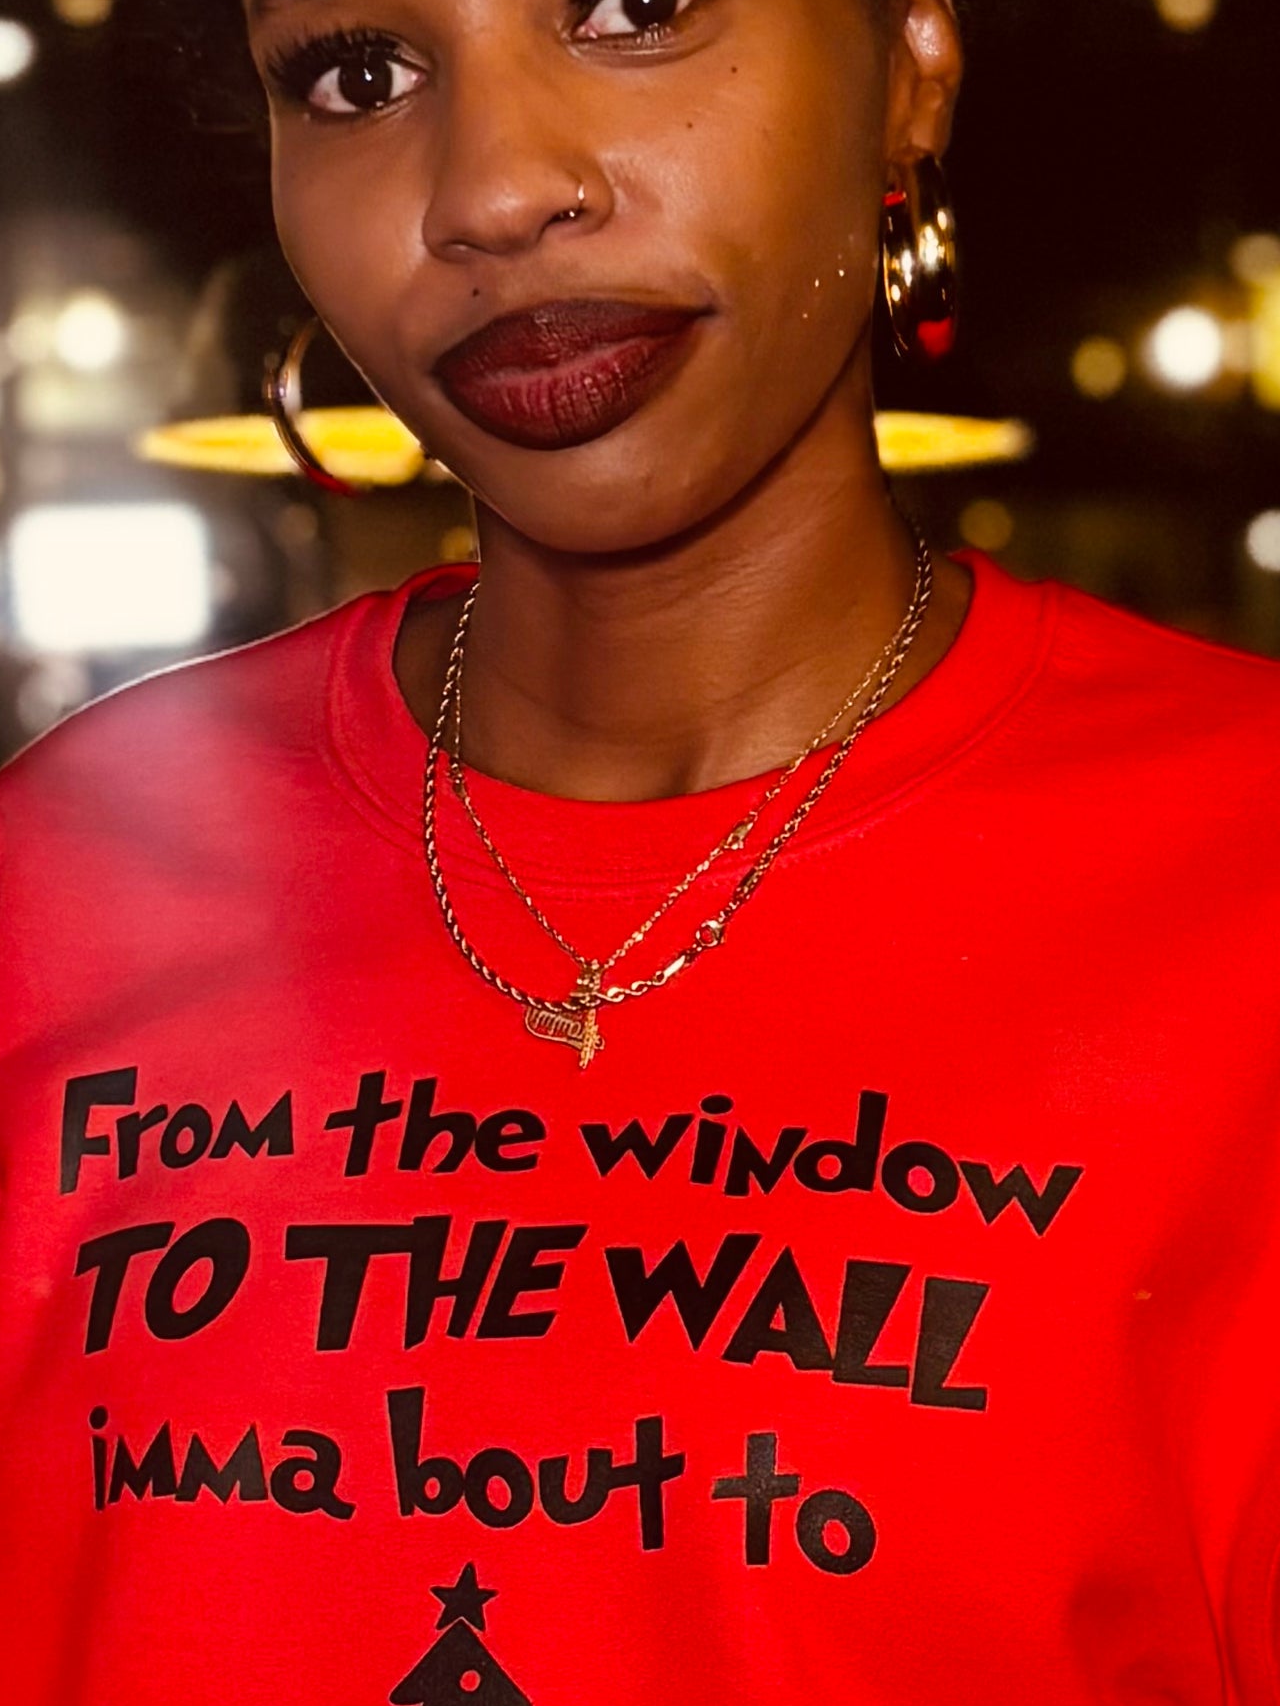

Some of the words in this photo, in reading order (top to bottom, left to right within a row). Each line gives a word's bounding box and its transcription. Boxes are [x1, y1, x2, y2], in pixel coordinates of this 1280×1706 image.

[324, 1071, 546, 1177] the
[74, 1217, 251, 1355] TO
[284, 1215, 588, 1351] THE
[604, 1233, 989, 1411] WALL
[387, 1386, 686, 1551] bout
[712, 1433, 876, 1576] to
